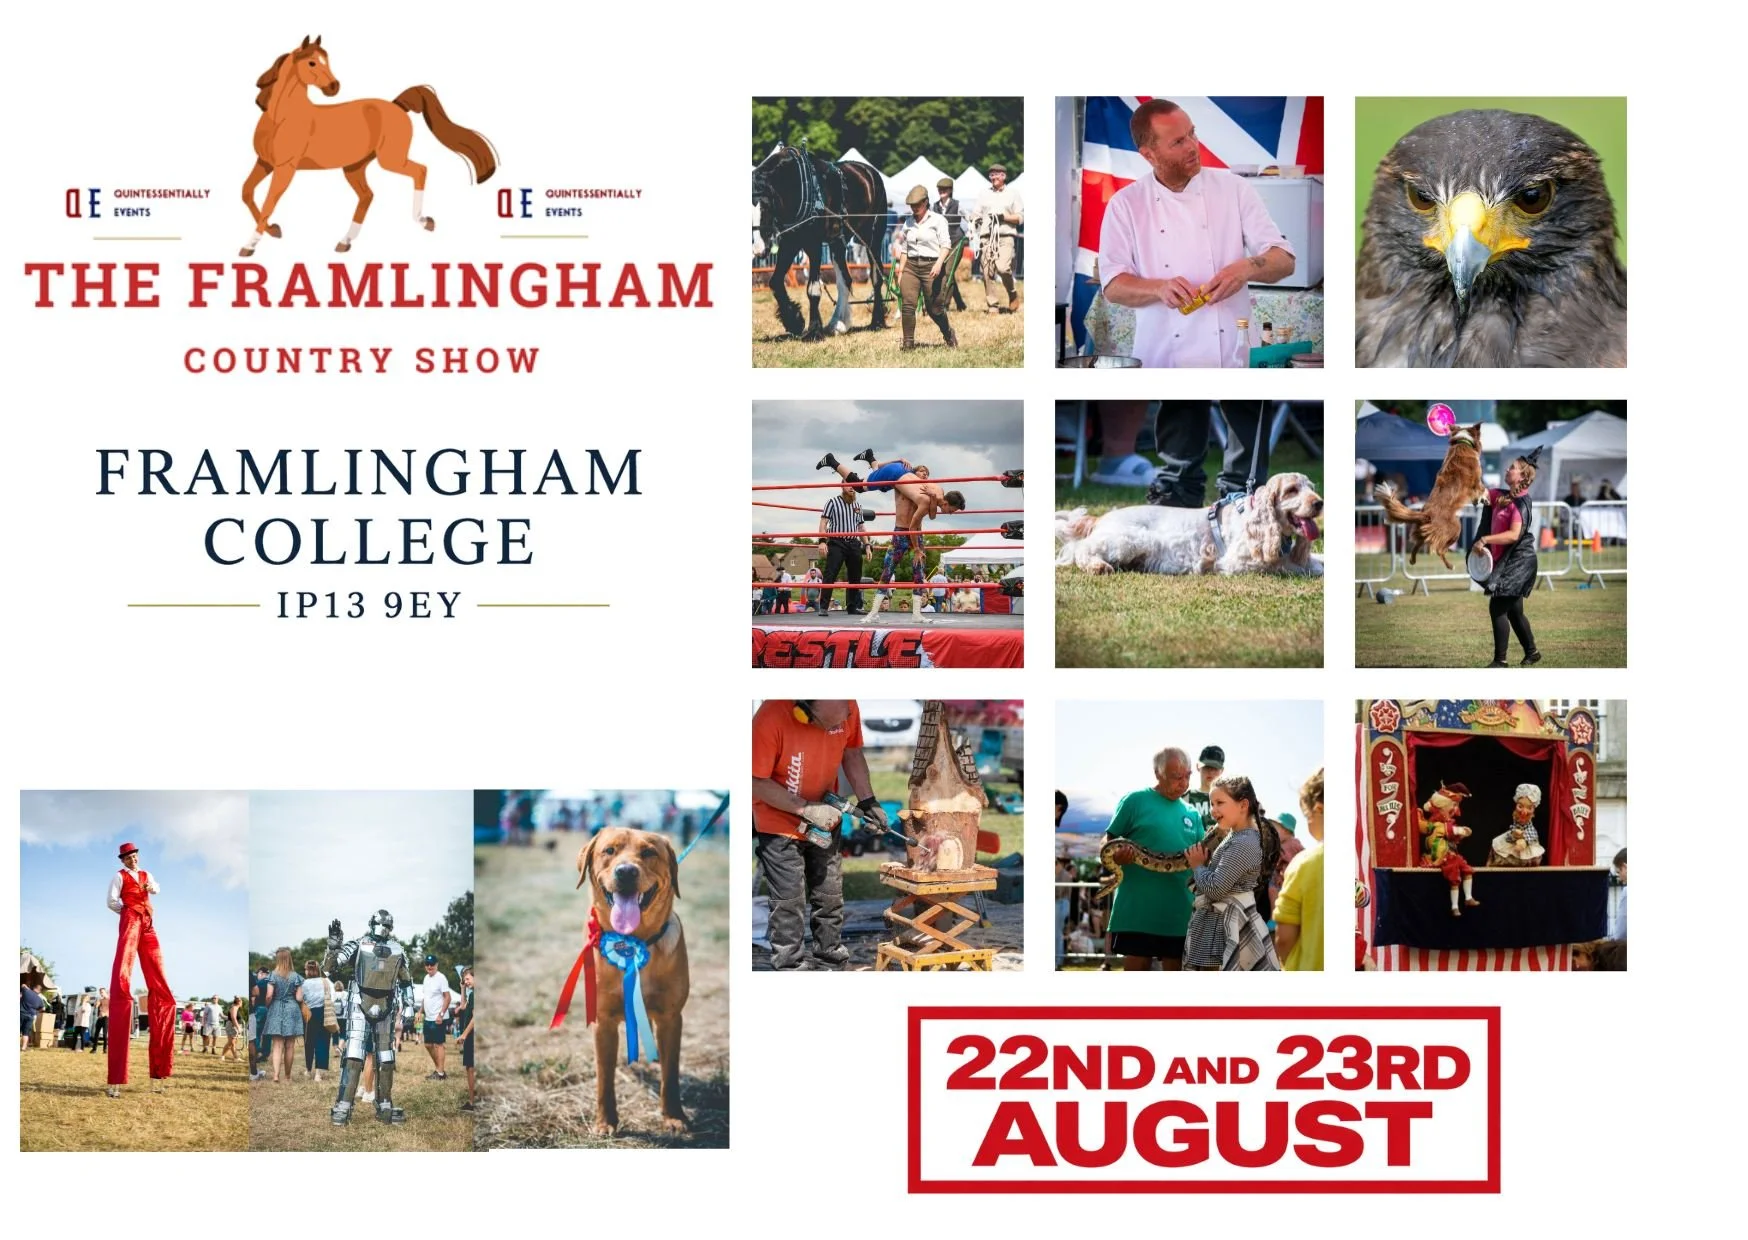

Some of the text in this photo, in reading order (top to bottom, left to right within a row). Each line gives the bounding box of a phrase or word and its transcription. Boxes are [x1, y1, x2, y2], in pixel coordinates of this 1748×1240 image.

[114, 189, 210, 198] QUINTESSENTIALLY
[545, 189, 642, 198] QUINTESSENTIALLY
[114, 208, 151, 217] EVENTS
[546, 208, 583, 217] EVENTS
[25, 263, 713, 308] THE FRAMLINGHAM
[184, 348, 540, 373] COUNTRY SHOW
[96, 448, 643, 496] FRAMLINGHAM
[204, 517, 533, 566] COLLEGE
[277, 591, 461, 619] IP13 9EY
[785, 751, 802, 795] akita
[947, 1035, 1471, 1091] 22ND AND 23RD
[972, 1100, 1433, 1168] AUGUST
